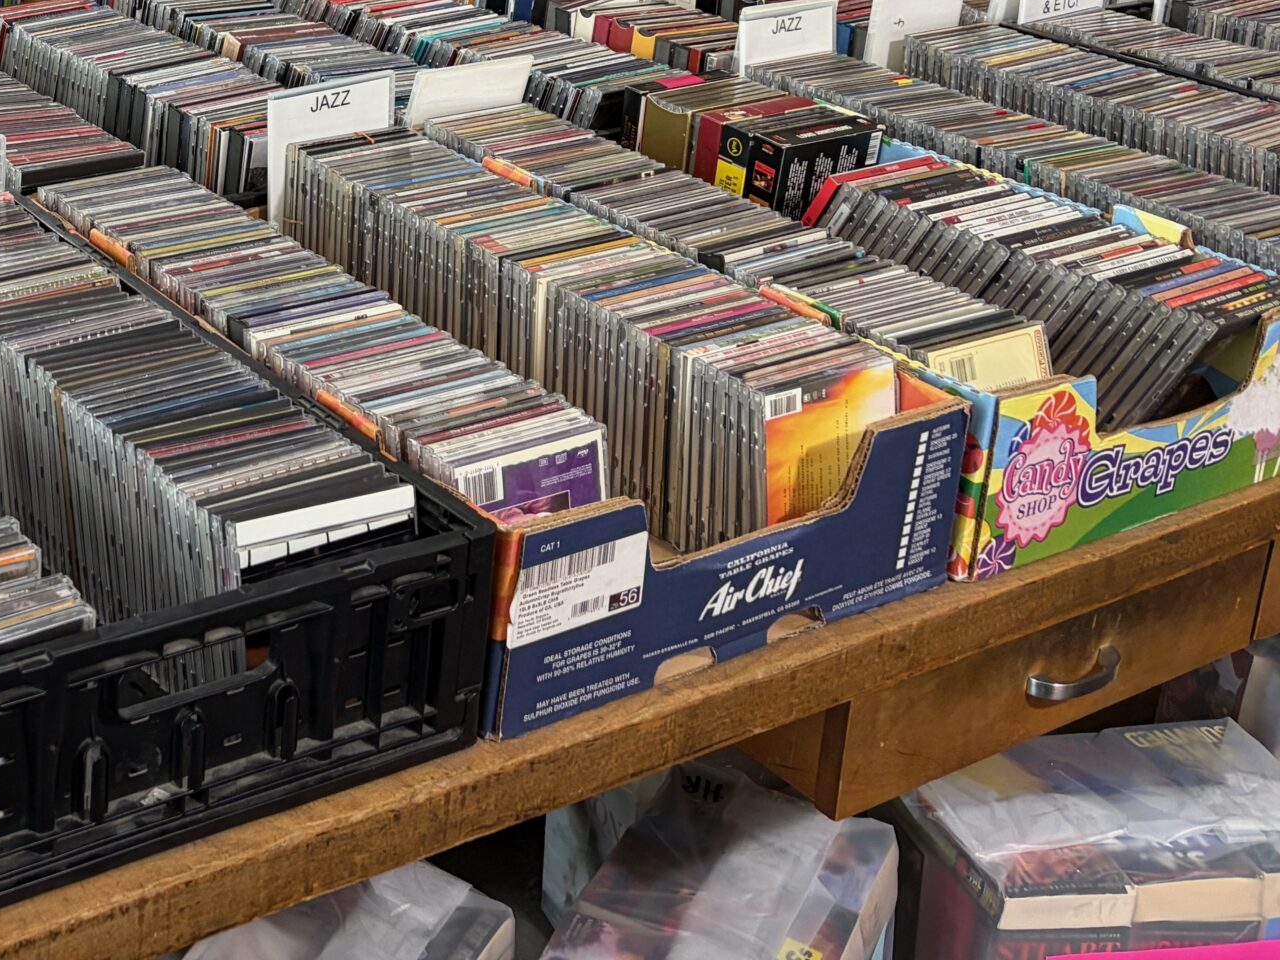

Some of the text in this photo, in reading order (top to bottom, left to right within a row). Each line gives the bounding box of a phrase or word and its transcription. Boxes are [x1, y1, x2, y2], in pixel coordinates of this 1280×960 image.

[1042, 0, 1052, 13] &
[772, 15, 802, 35] JAZZ
[310, 90, 351, 113] JAZZ
[1003, 438, 1089, 503] Candy
[1076, 429, 1234, 510] Grapes
[1016, 495, 1056, 520] SHOP
[539, 540, 561, 552] CAT 1
[724, 540, 790, 569] CALIFORNIA
[717, 546, 795, 580] TABLE GRAPES
[616, 587, 640, 607] 56
[699, 581, 746, 623] Air
[744, 559, 804, 604] Chief
[542, 629, 632, 663] IDEAL STORAGE CONDITIONS
[551, 648, 598, 669] FOR GRAPES IS
[535, 644, 636, 682] WITH RELATIVE HUMIDITY
[522, 676, 641, 722] SULPHUR DIOXIDE FOR FUNGICIDE USE.
[535, 672, 630, 709] MAY HAVE BEEN TREATED WITH
